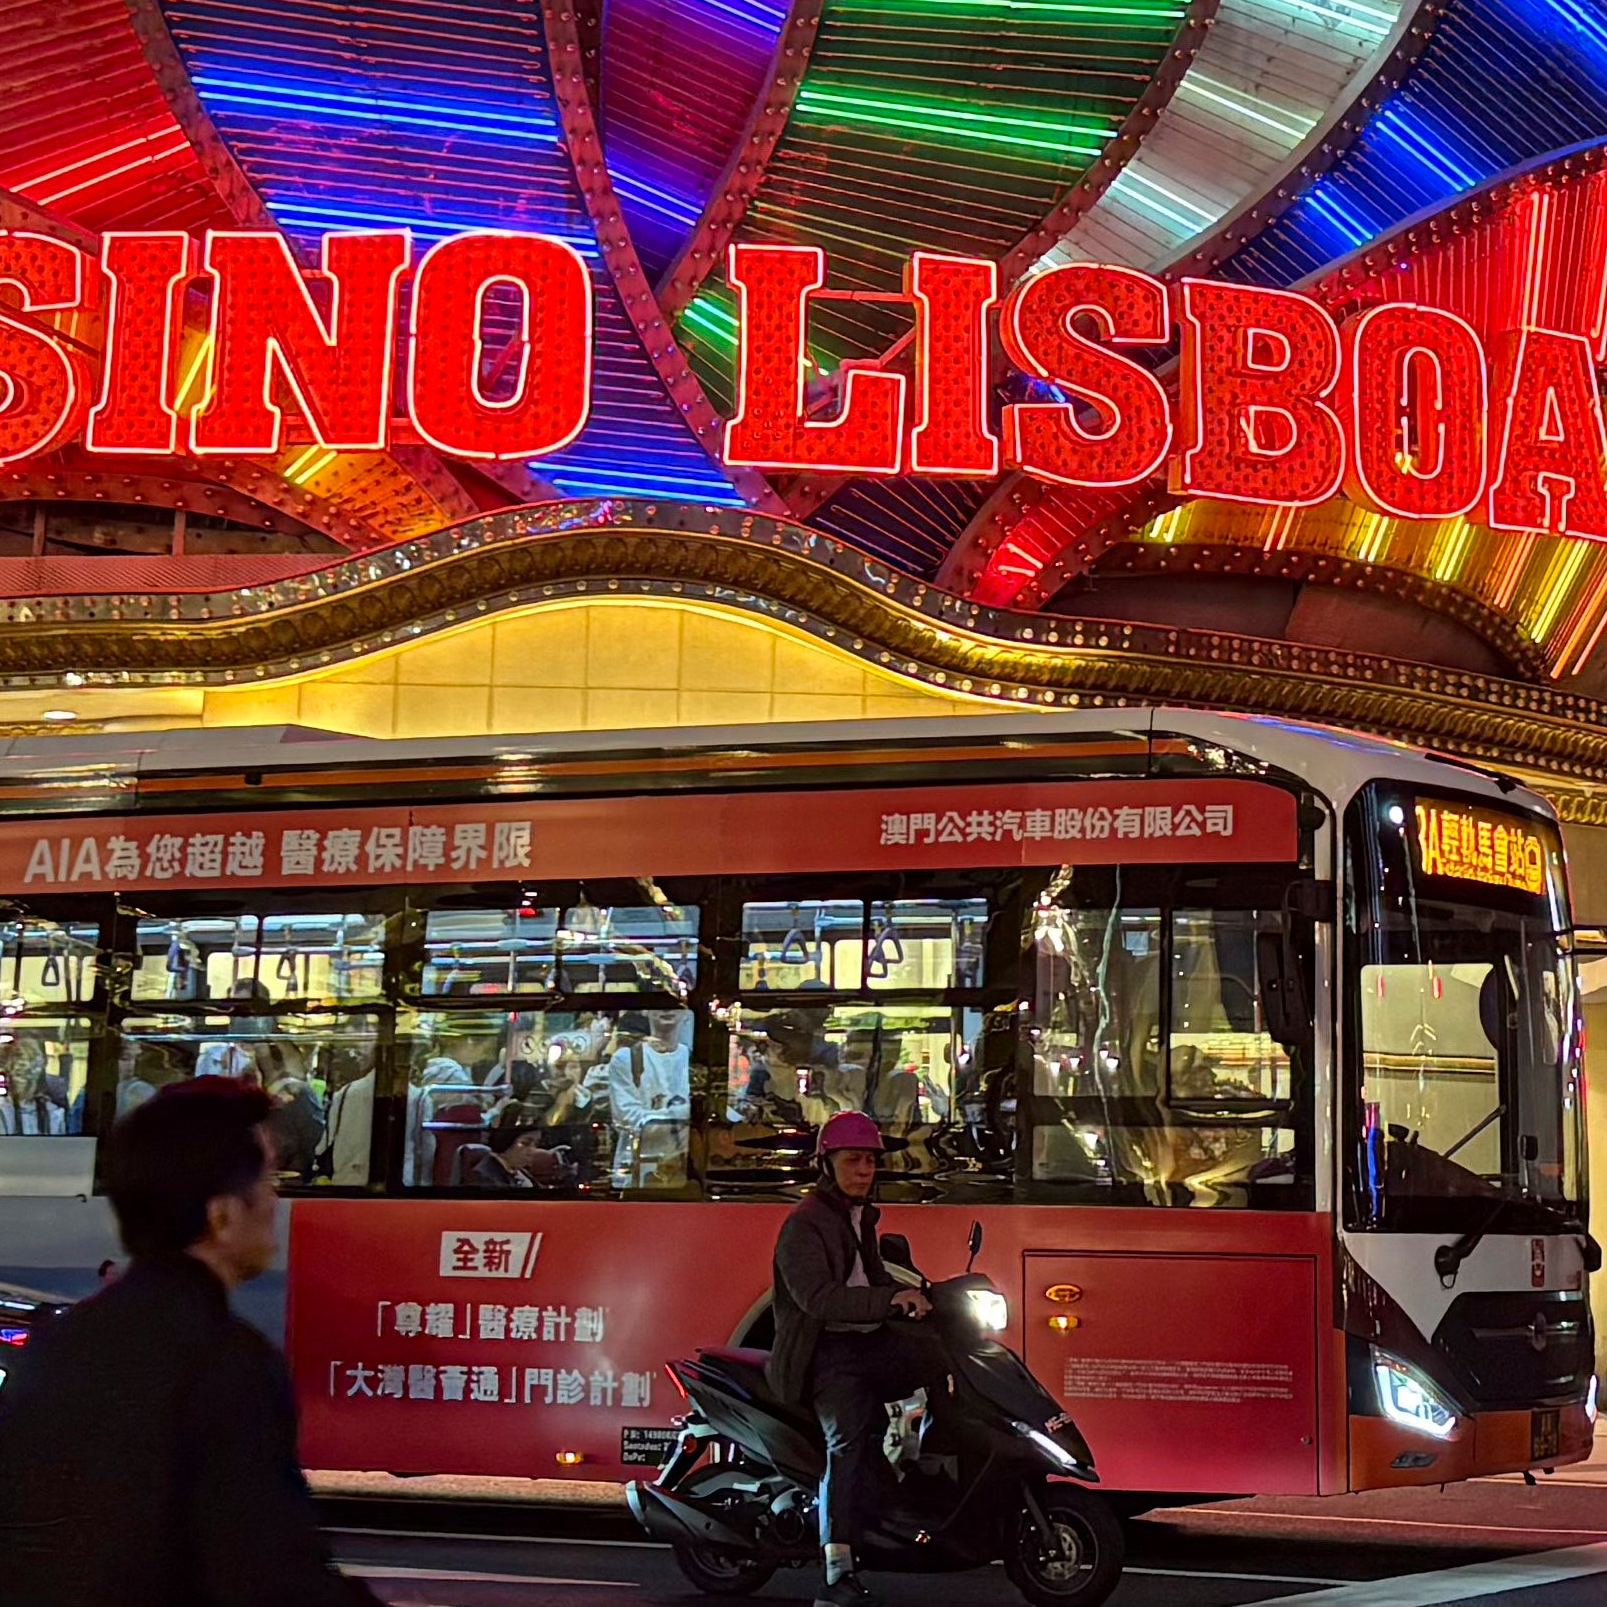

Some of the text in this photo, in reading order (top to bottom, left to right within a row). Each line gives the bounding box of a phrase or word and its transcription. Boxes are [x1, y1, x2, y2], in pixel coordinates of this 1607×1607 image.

[879, 804, 1234, 845] 澳門公共汽車股份有限公司
[23, 820, 533, 884] AIA為您超越 醫療保障界限
[451, 1237, 513, 1274] 全新
